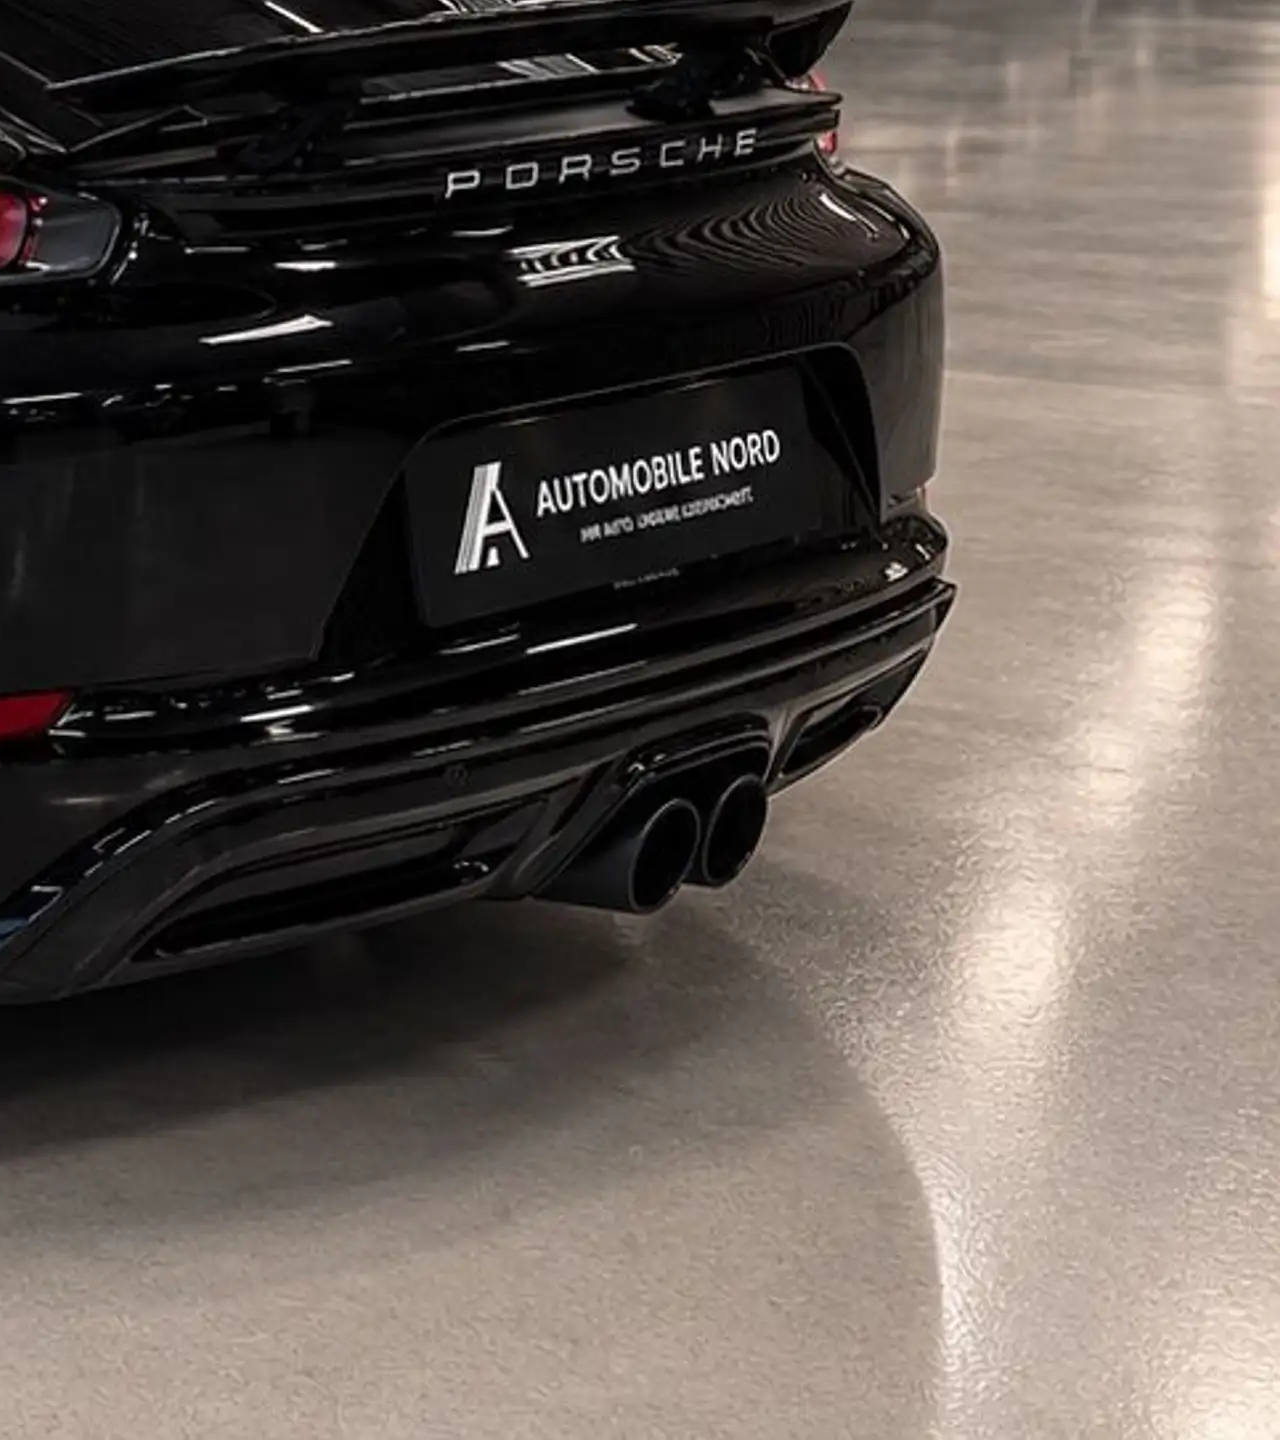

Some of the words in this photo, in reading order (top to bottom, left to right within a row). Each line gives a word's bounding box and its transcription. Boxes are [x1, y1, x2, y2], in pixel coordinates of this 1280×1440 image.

[444, 127, 759, 199] PORSCHE
[537, 446, 705, 517] AUTOMOBILE
[710, 429, 781, 476] NORD
